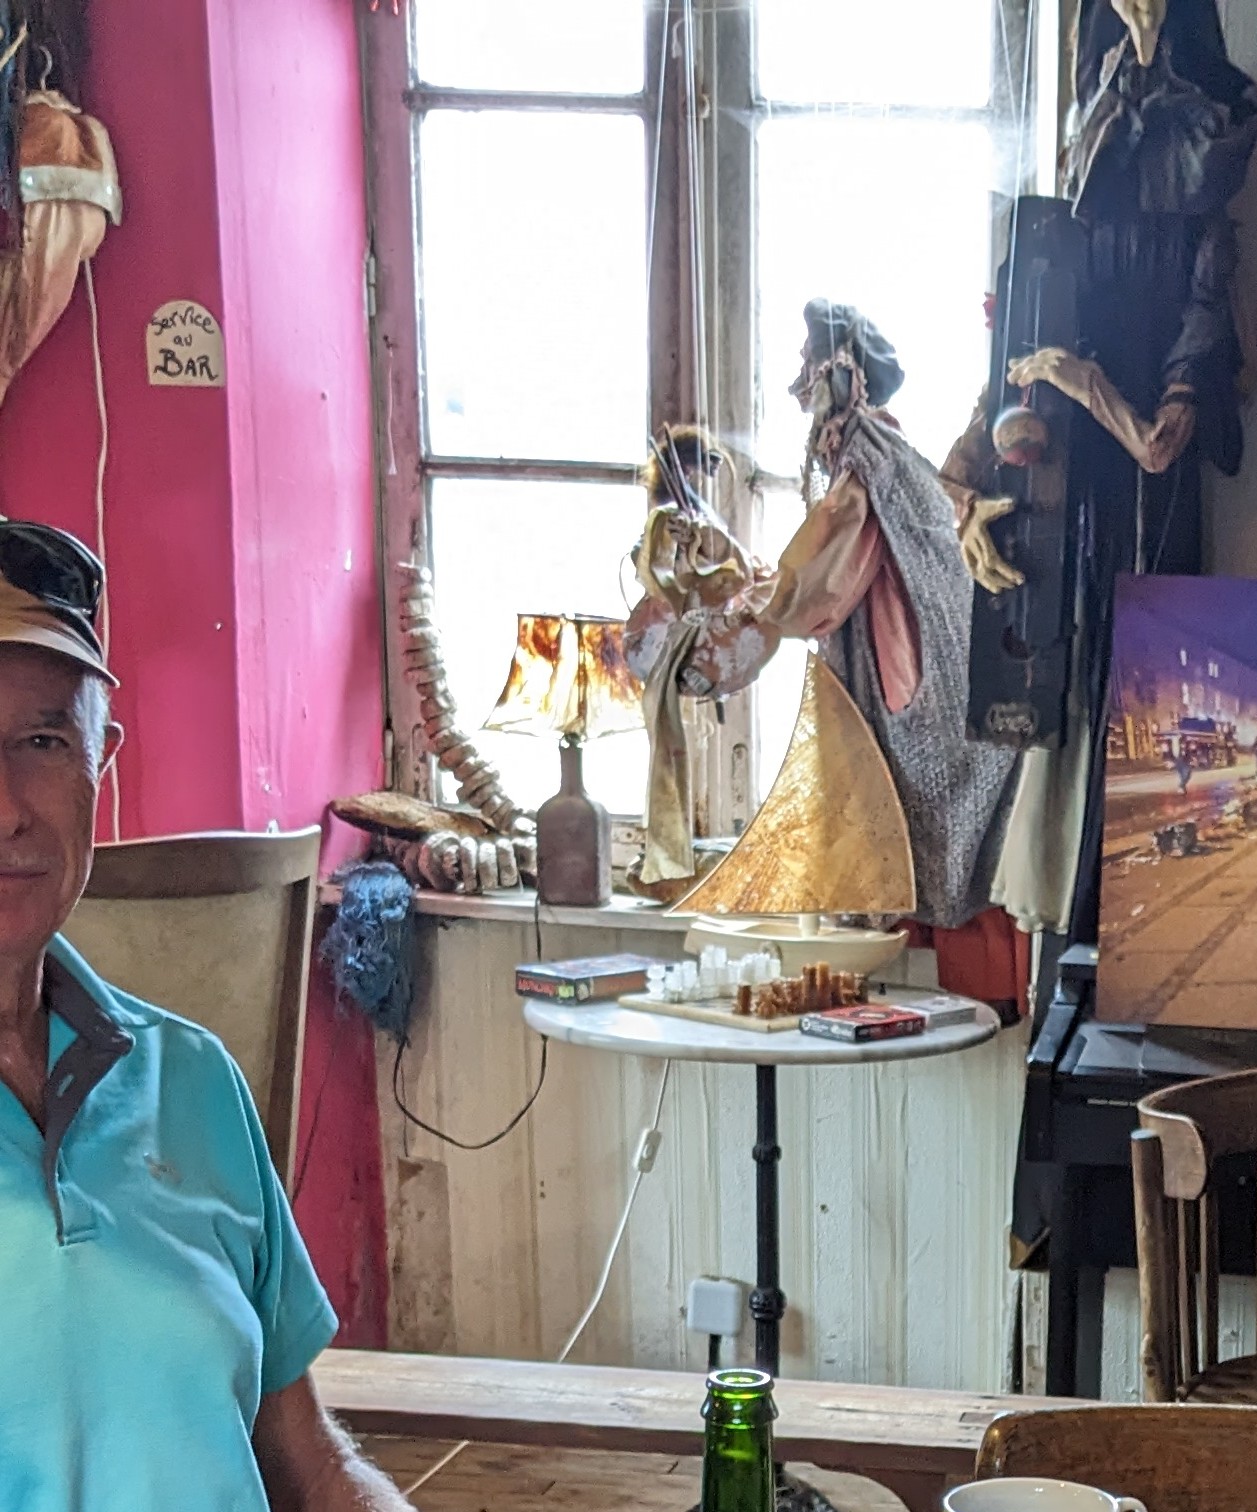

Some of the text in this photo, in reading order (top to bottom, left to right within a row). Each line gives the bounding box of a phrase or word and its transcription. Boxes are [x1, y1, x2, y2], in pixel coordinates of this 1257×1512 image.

[151, 306, 215, 336] Service
[173, 334, 193, 347] au
[153, 348, 219, 381] BAR
